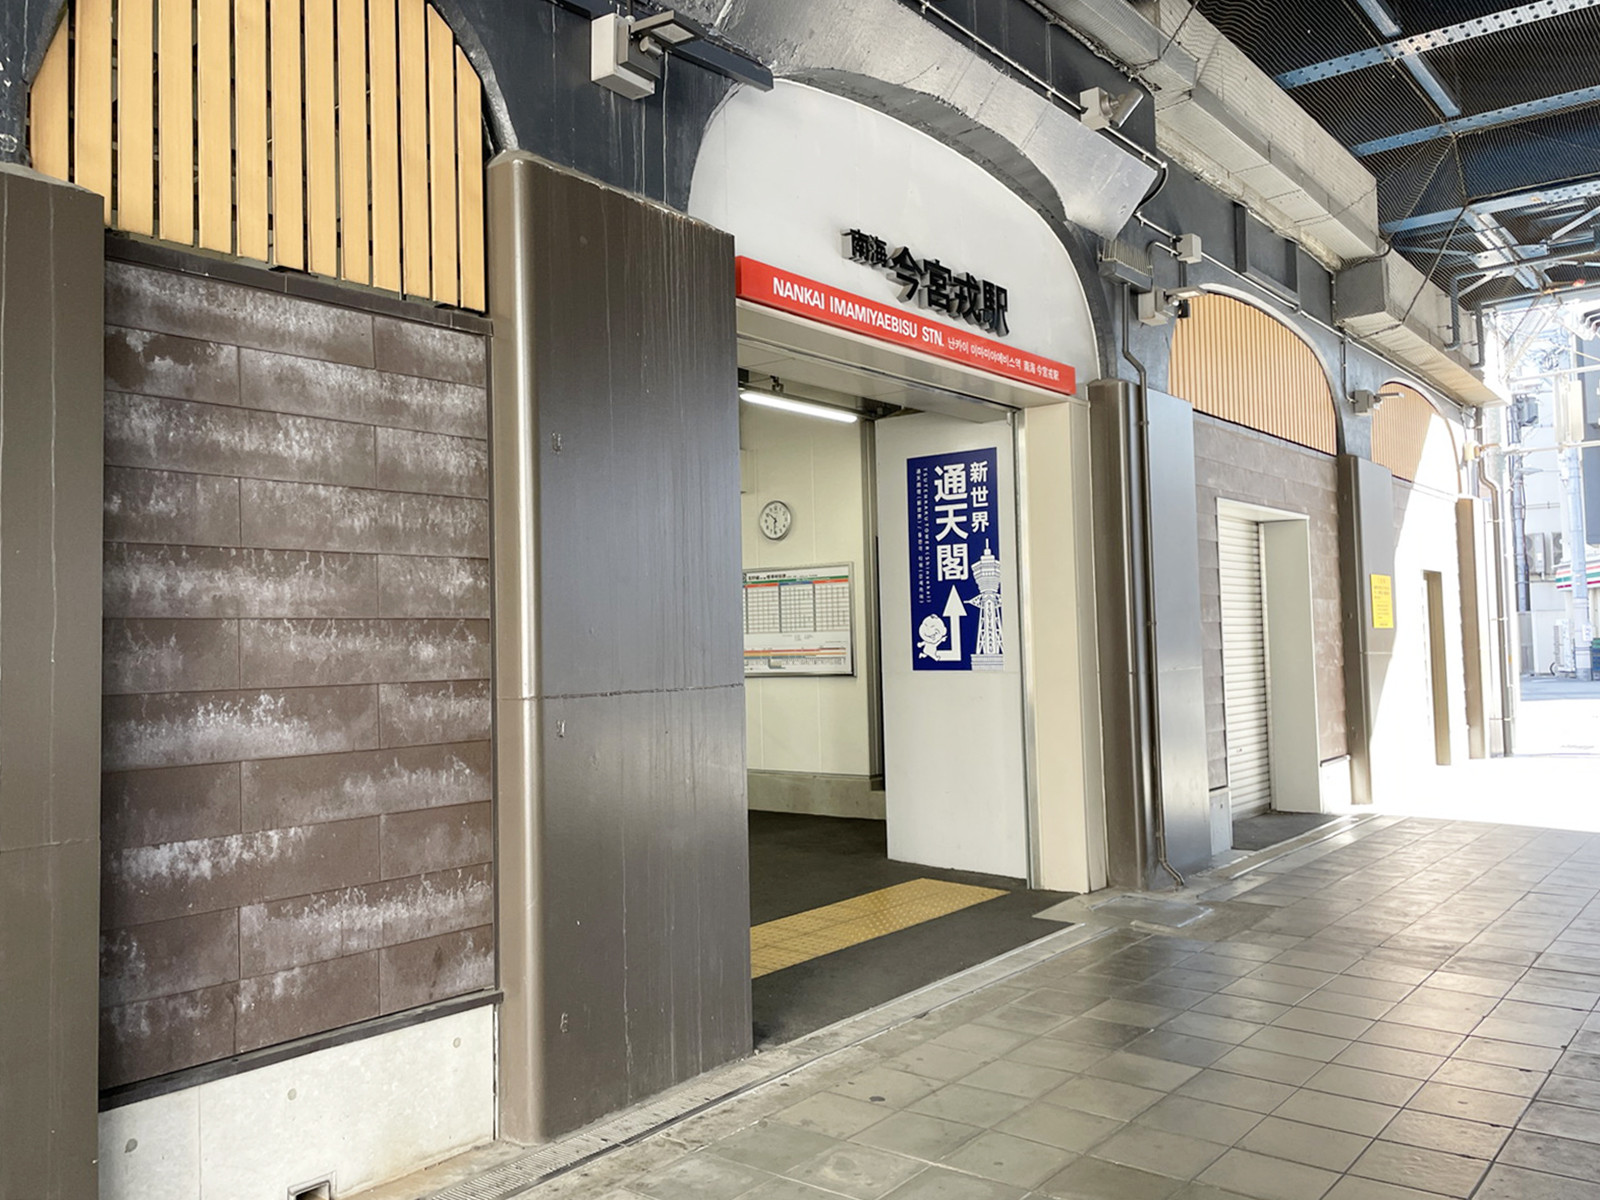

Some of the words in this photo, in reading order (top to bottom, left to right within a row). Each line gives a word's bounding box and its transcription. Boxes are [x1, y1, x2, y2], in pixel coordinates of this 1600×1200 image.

[773, 277, 825, 310] NANKAI
[830, 296, 918, 338] IMAMIYAEBISU
[922, 326, 945, 347] STN.
[843, 229, 888, 268] 南海
[887, 246, 1010, 337] 今宮戎駅
[947, 337, 969, 354] 난카이
[934, 463, 970, 582] 通天閣
[970, 461, 990, 534] 新世界
